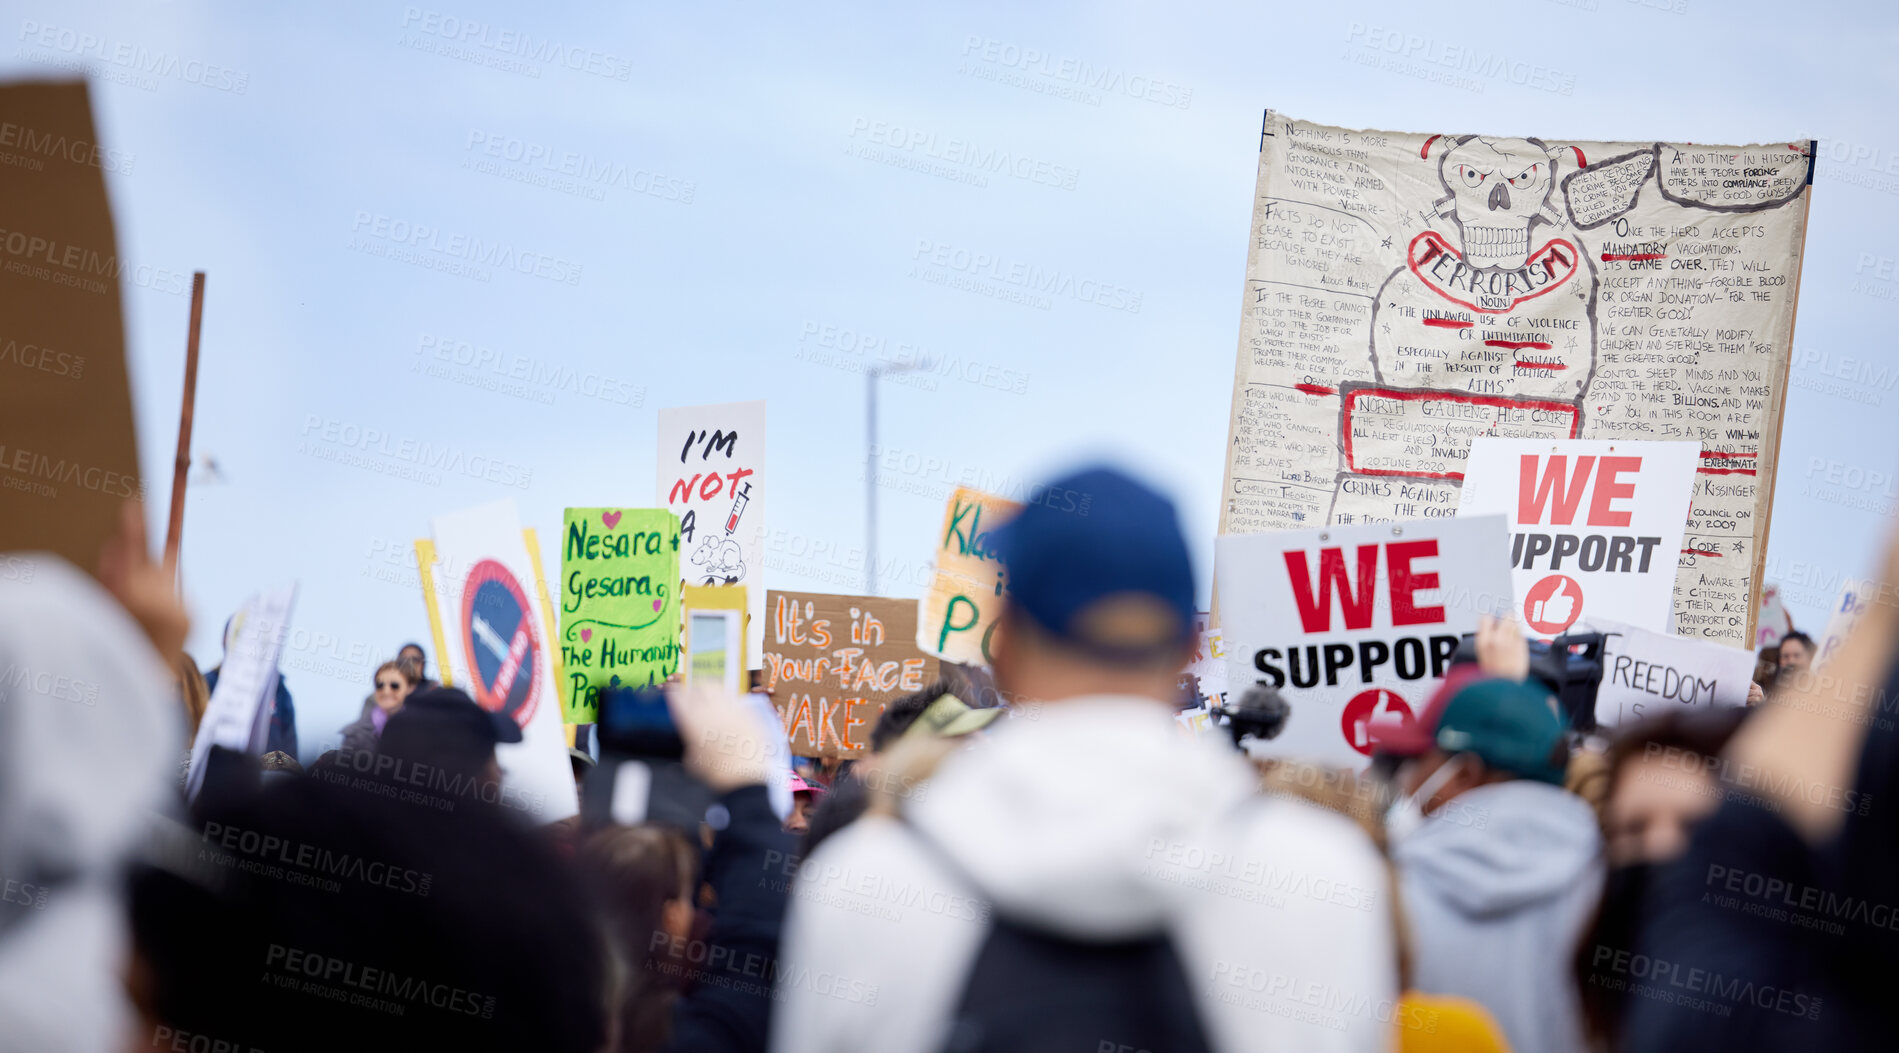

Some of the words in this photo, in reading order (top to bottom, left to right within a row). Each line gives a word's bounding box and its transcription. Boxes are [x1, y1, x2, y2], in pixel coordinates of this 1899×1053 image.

[1417, 238, 1573, 295] TERRORISM
[681, 429, 737, 463] I'M
[669, 467, 753, 504] NOT
[1517, 455, 1642, 527] WE
[567, 519, 661, 561] Nesara
[1509, 533, 1661, 573] UPPORT
[1283, 539, 1446, 633] WE
[775, 594, 831, 649] It's
[850, 608, 885, 646] in
[562, 645, 592, 667] The
[601, 634, 679, 674] Humanity
[1253, 632, 1477, 690] SUPPOR
